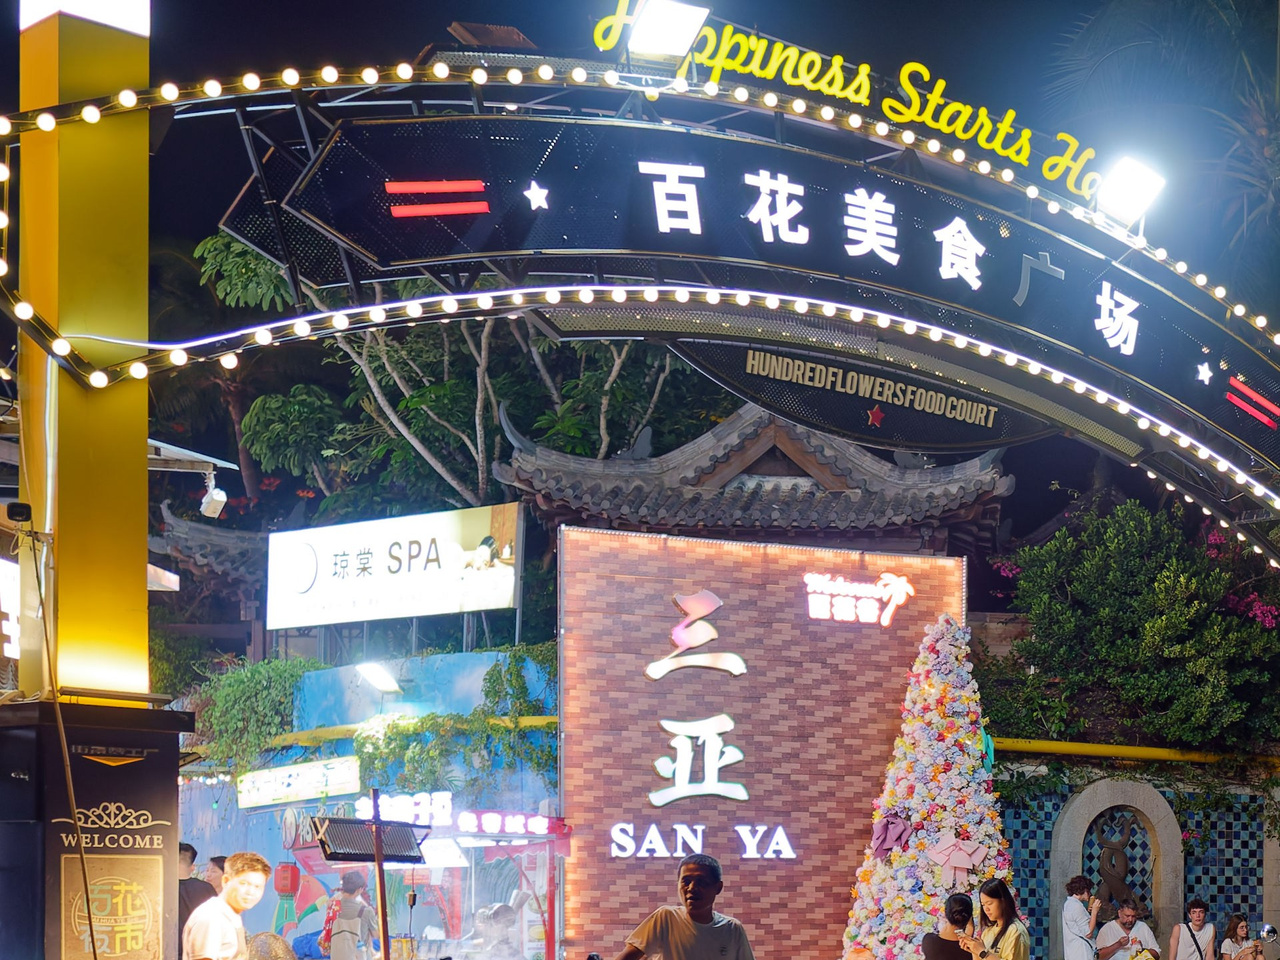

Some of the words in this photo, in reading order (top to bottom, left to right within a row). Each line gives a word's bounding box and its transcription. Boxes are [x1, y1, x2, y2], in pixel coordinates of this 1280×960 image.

[593, 0, 871, 105] Hppiness
[881, 61, 1032, 168] Starts
[1042, 132, 1102, 200] He
[637, 161, 1141, 356] 百花美食广场
[387, 537, 442, 575] SPA
[60, 832, 164, 849] WELCOME
[610, 822, 706, 859] SAN
[734, 824, 797, 860] YA
